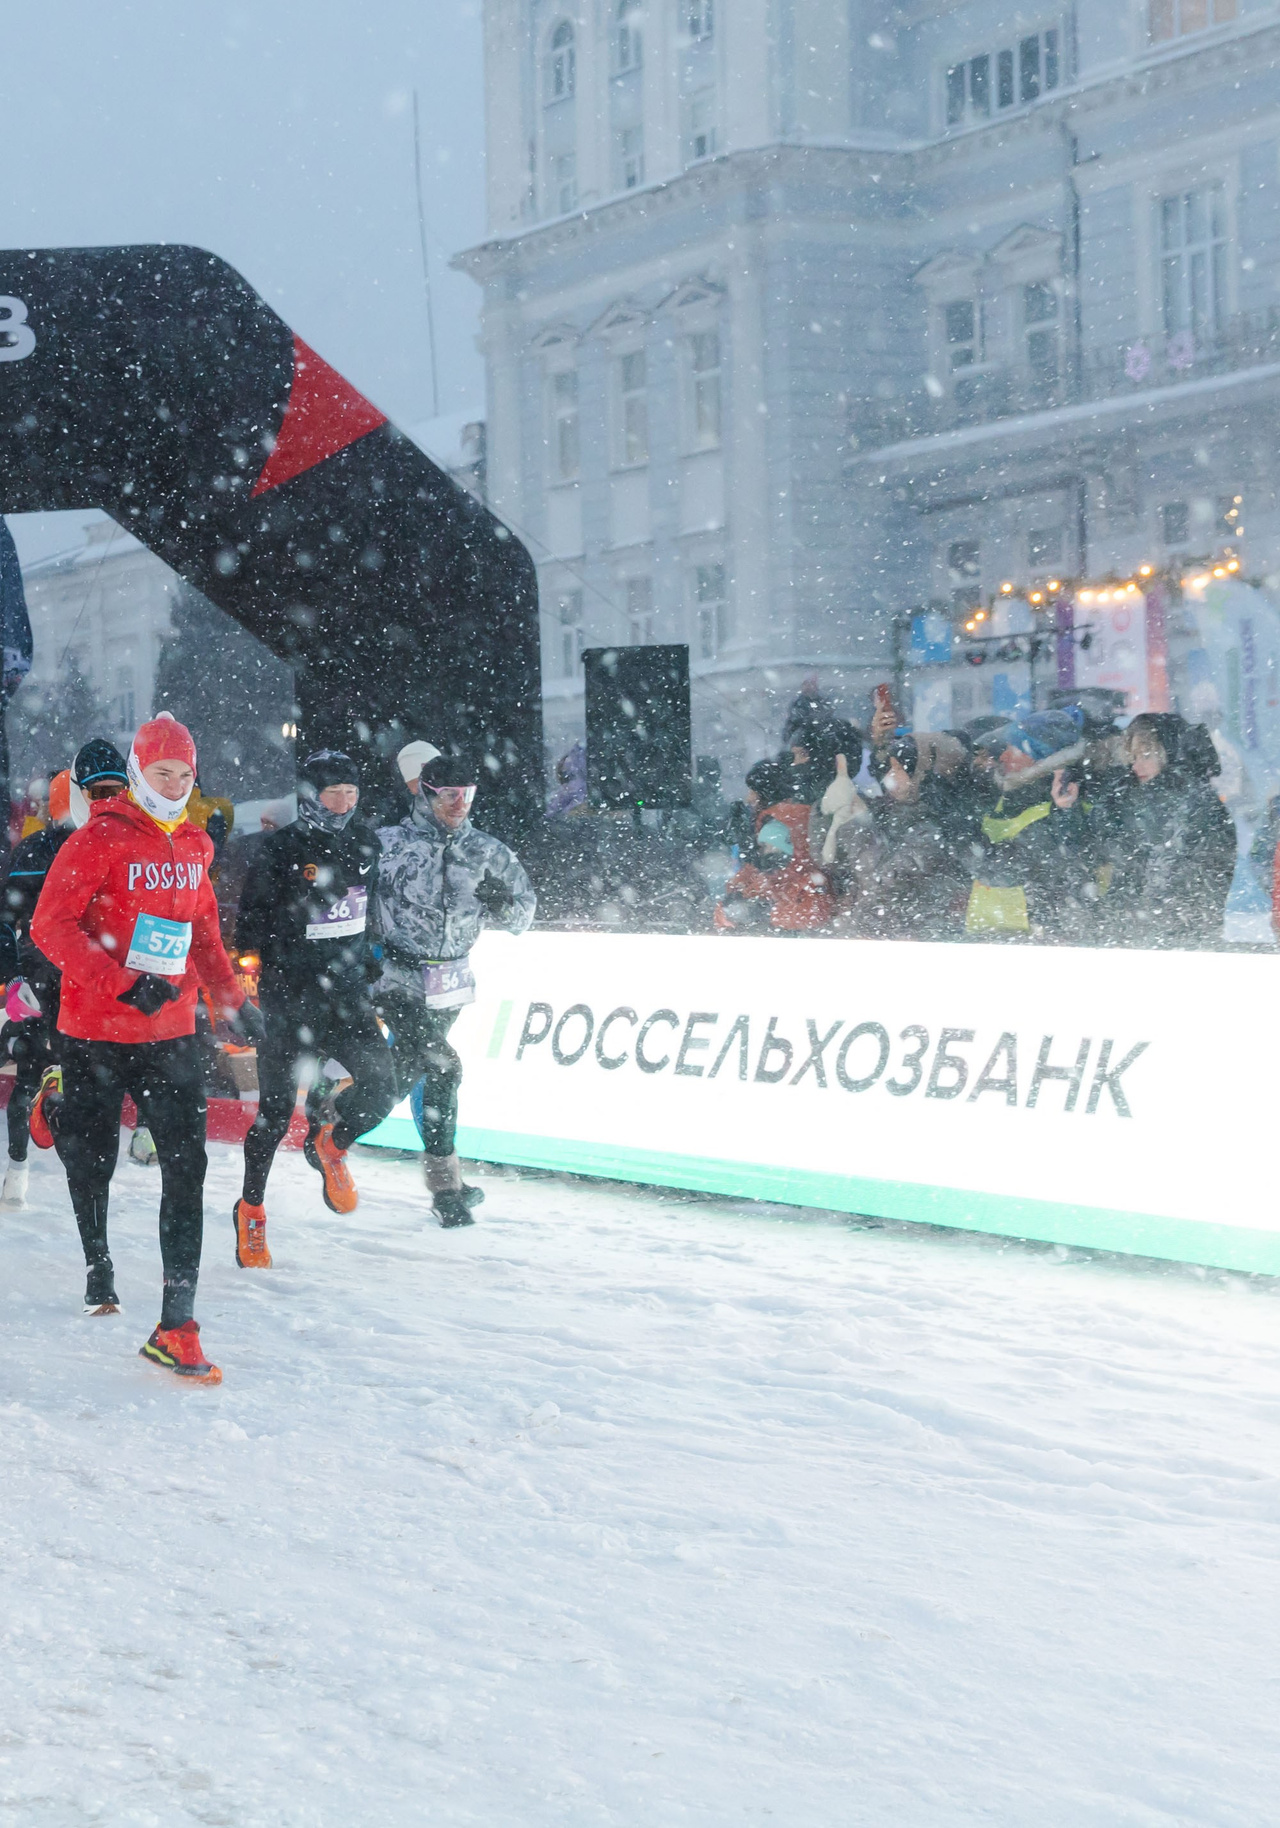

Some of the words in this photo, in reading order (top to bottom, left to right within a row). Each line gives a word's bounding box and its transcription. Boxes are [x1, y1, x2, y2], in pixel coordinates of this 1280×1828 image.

[148, 931, 185, 956] 575
[441, 971, 459, 991] 56
[515, 1001, 1152, 1118] РОССЕЛЬХОЗБАНК
